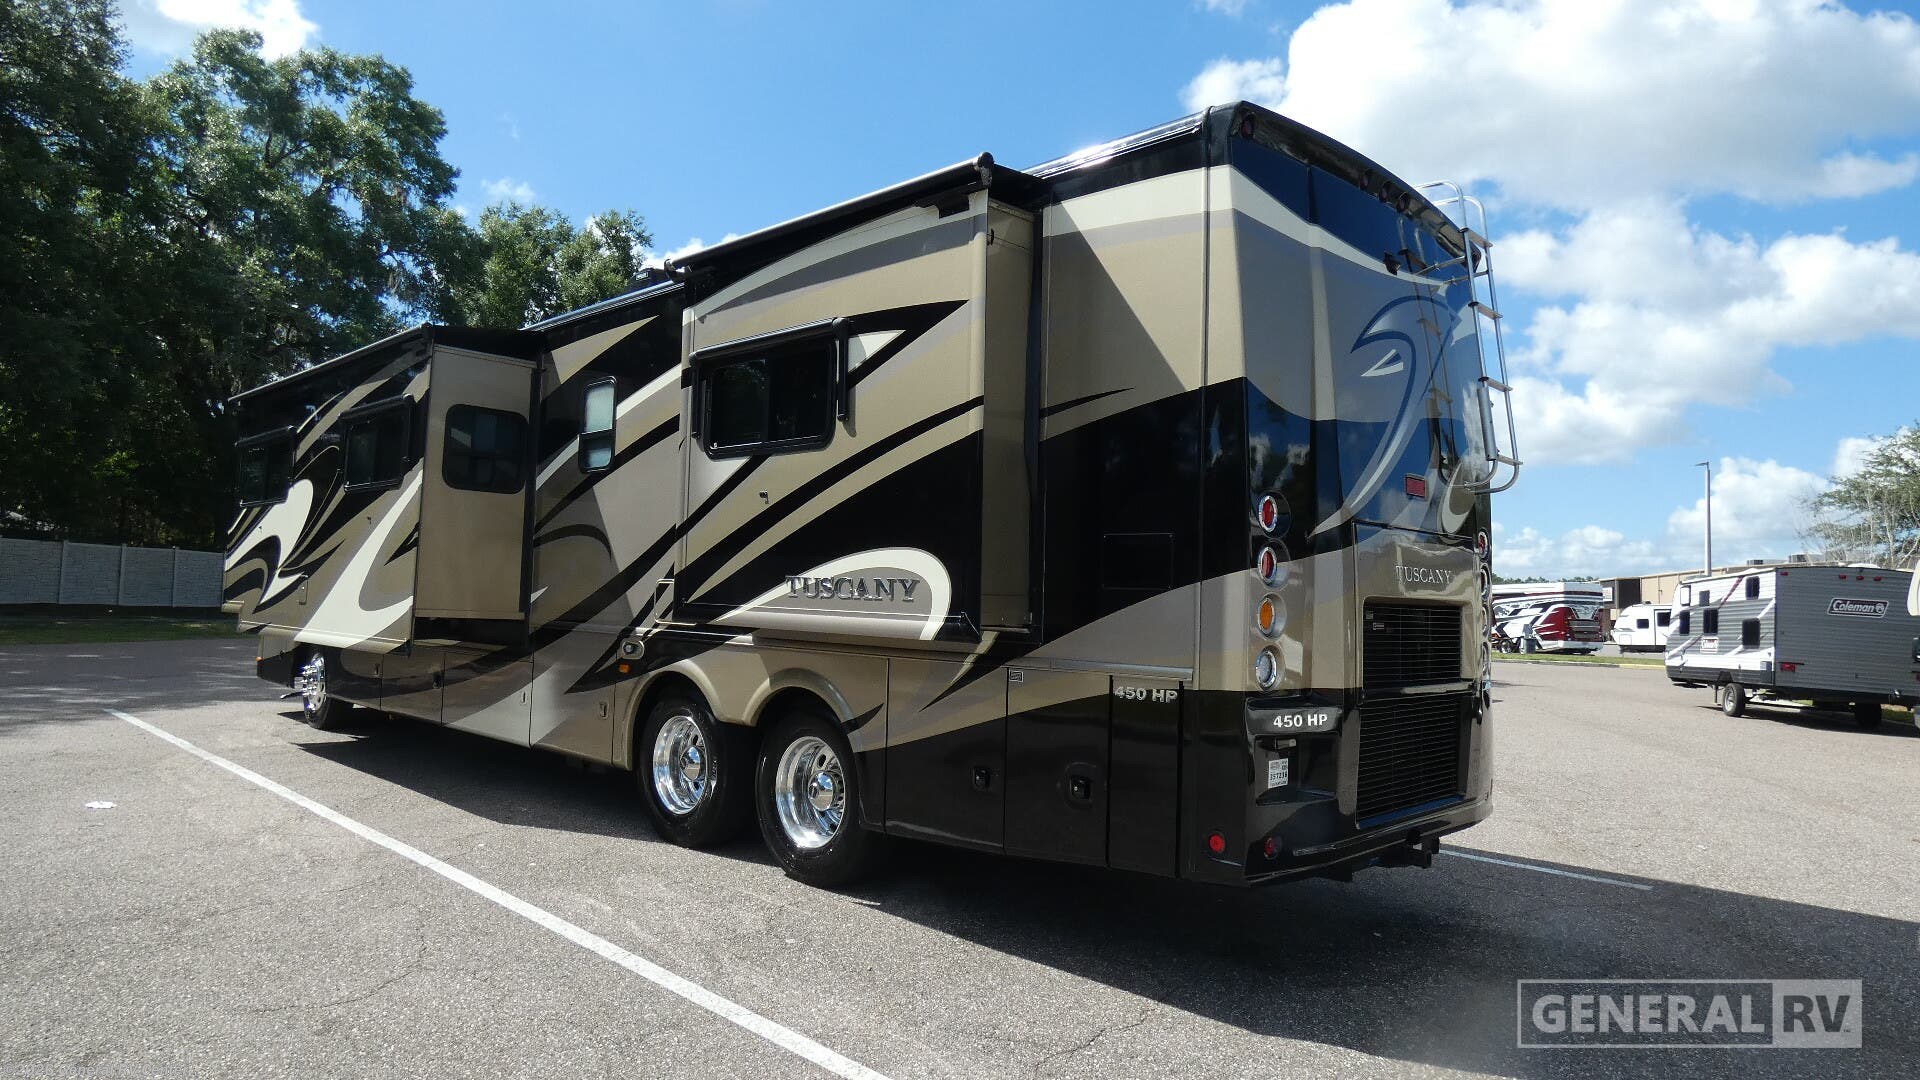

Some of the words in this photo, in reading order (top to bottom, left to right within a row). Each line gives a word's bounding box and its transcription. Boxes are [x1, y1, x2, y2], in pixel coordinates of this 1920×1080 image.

[1395, 565, 1452, 585] TUSCANY
[785, 575, 920, 602] TUSCANY
[1833, 600, 1874, 612] Coleman
[1114, 686, 1147, 701] 450
[1152, 688, 1178, 703] HP
[1273, 714, 1303, 728] 450
[1307, 713, 1328, 727] HP
